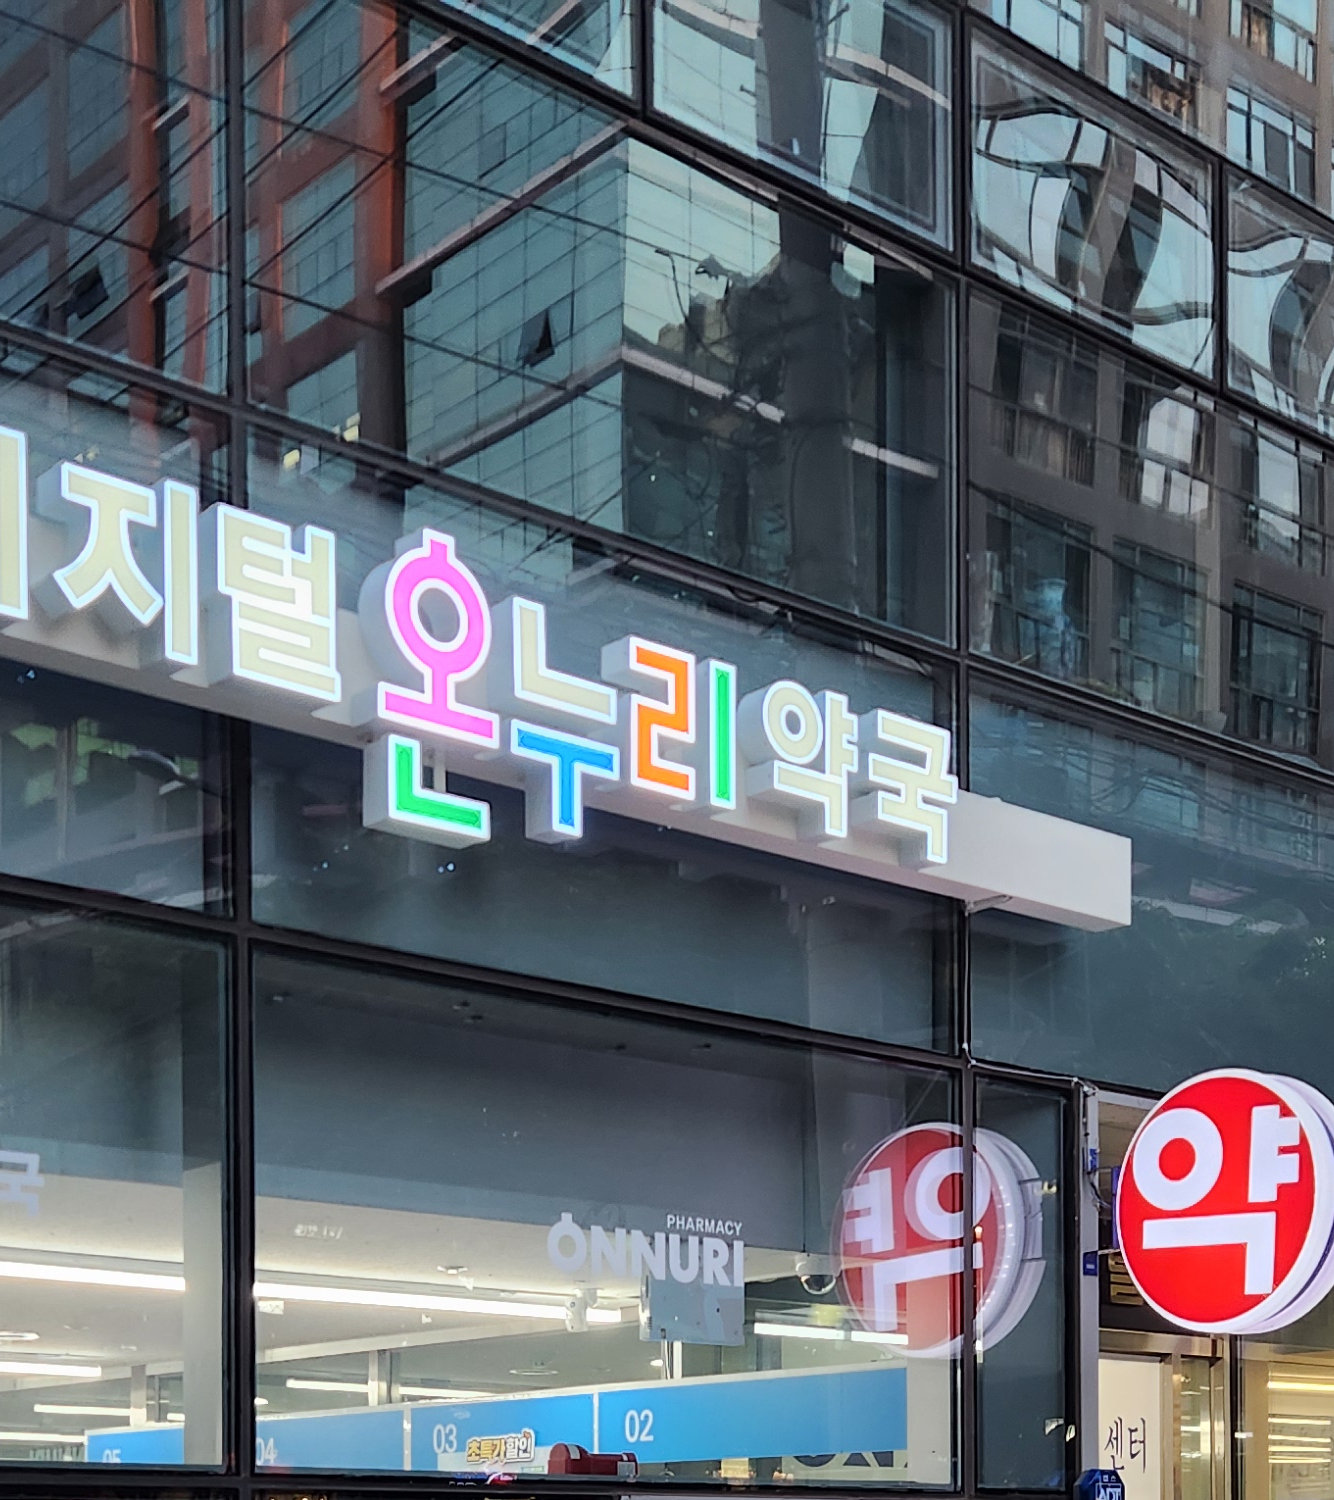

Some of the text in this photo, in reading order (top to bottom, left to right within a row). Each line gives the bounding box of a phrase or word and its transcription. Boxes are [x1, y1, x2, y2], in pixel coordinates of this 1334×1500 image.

[1131, 1103, 1304, 1296] 약
[666, 1212, 744, 1237] PHARMACY
[546, 1211, 746, 1290] ONNURI
[432, 1423, 458, 1455] 03
[624, 1409, 655, 1443] 02
[1104, 1416, 1147, 1474] 센터
